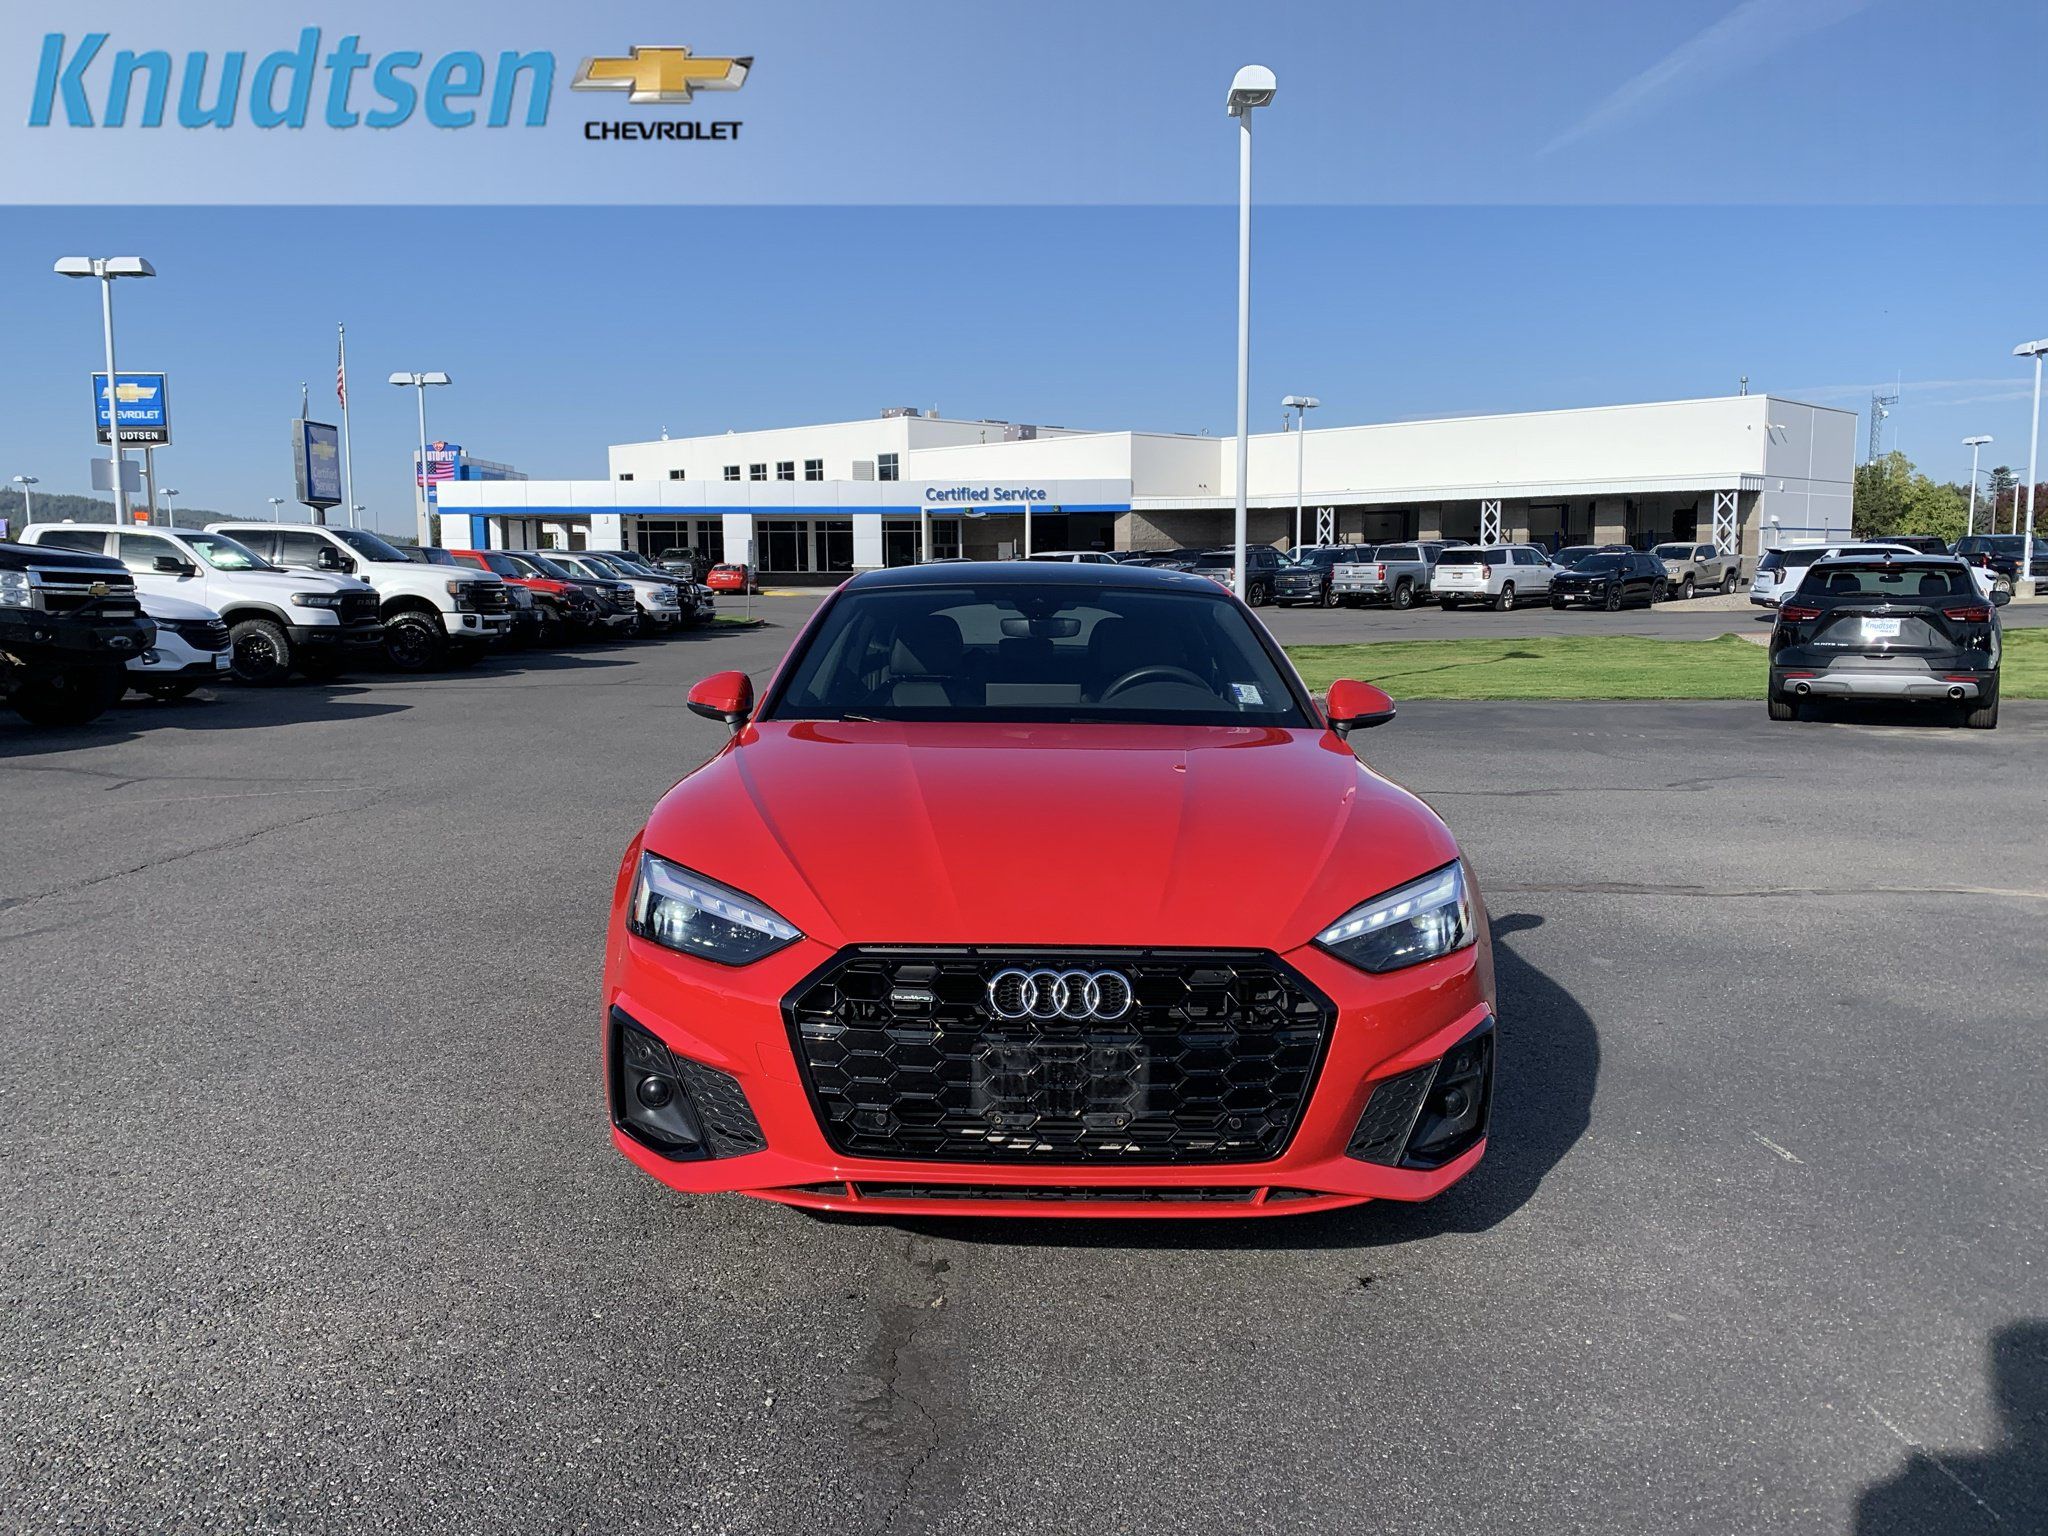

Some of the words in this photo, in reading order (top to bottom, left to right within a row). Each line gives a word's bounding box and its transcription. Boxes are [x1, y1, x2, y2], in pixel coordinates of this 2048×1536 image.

[106, 431, 159, 440] KUDTSEN
[925, 487, 990, 501] Certified
[993, 487, 1047, 501] Service
